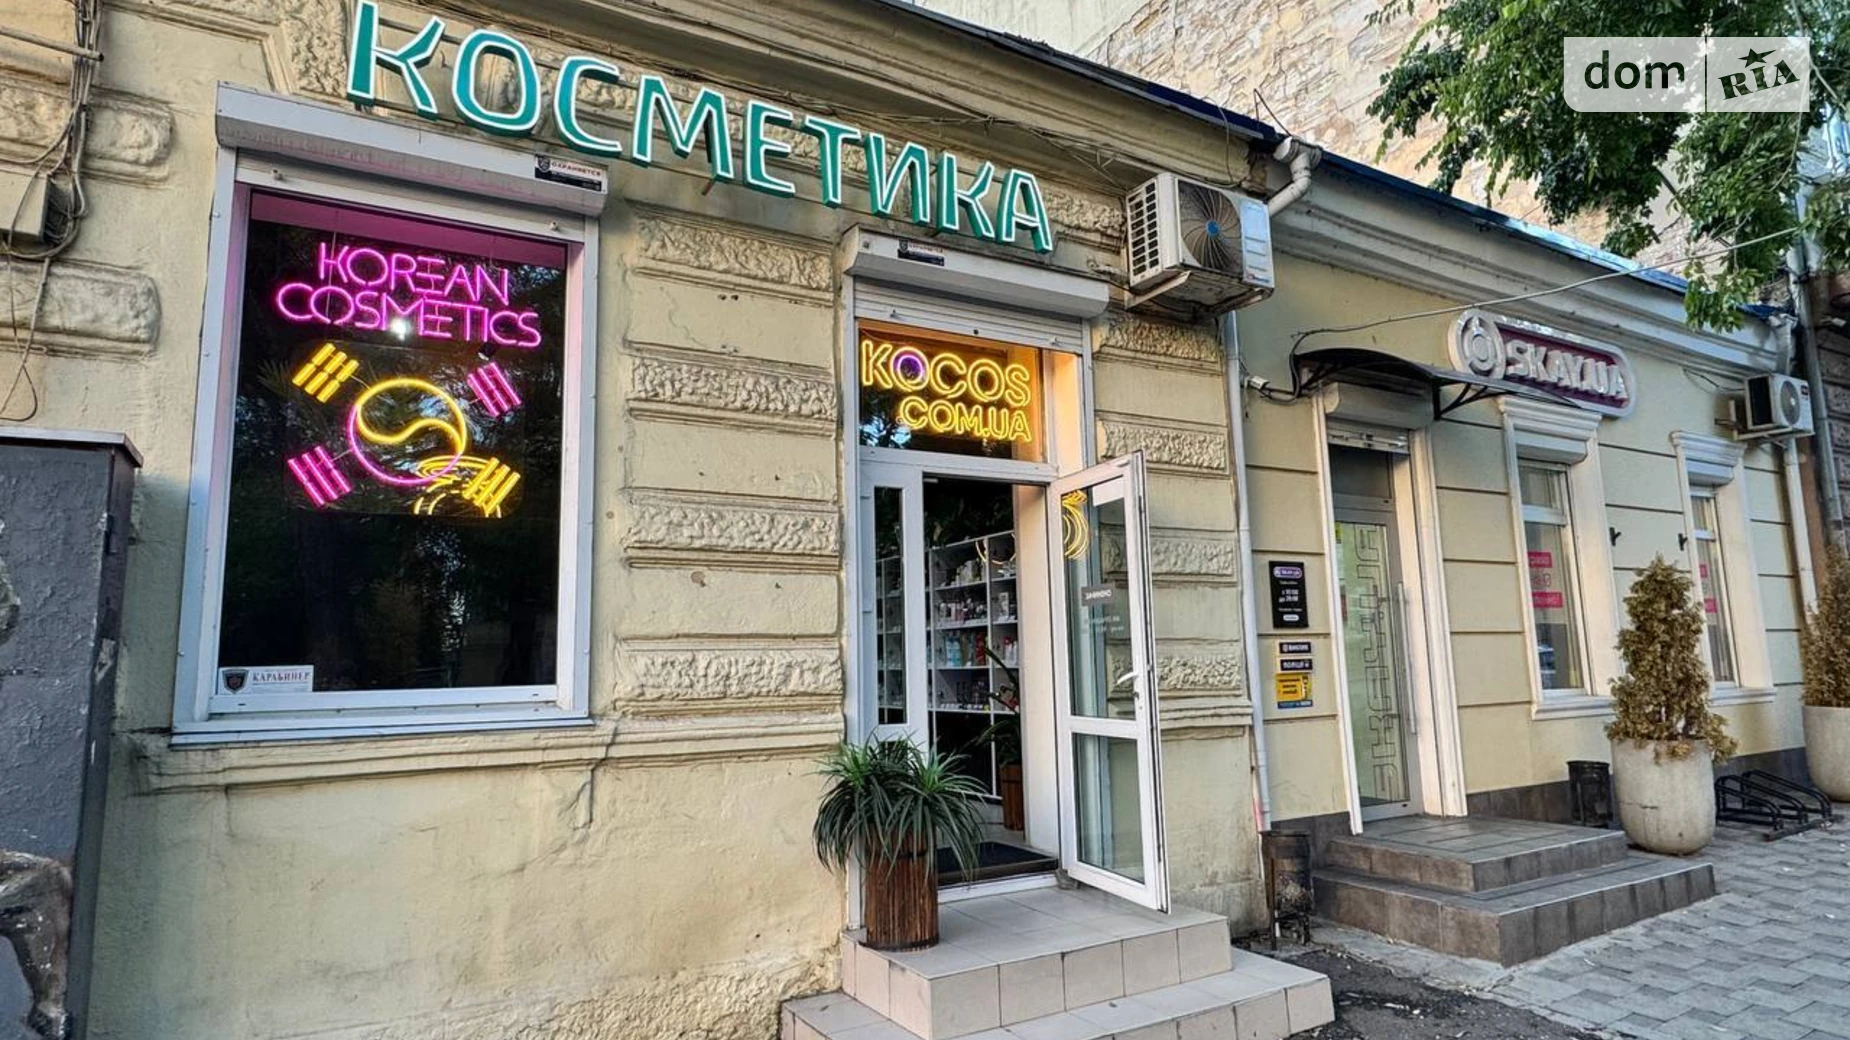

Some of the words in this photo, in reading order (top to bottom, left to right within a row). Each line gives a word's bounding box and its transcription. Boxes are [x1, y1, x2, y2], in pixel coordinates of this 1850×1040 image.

[347, 1, 1052, 254] КОСМЕТИКА
[320, 242, 509, 306] KOREAN
[276, 283, 542, 347] COSMETICS
[862, 340, 1032, 407] KOCOS
[900, 395, 1032, 441] COM.UA
